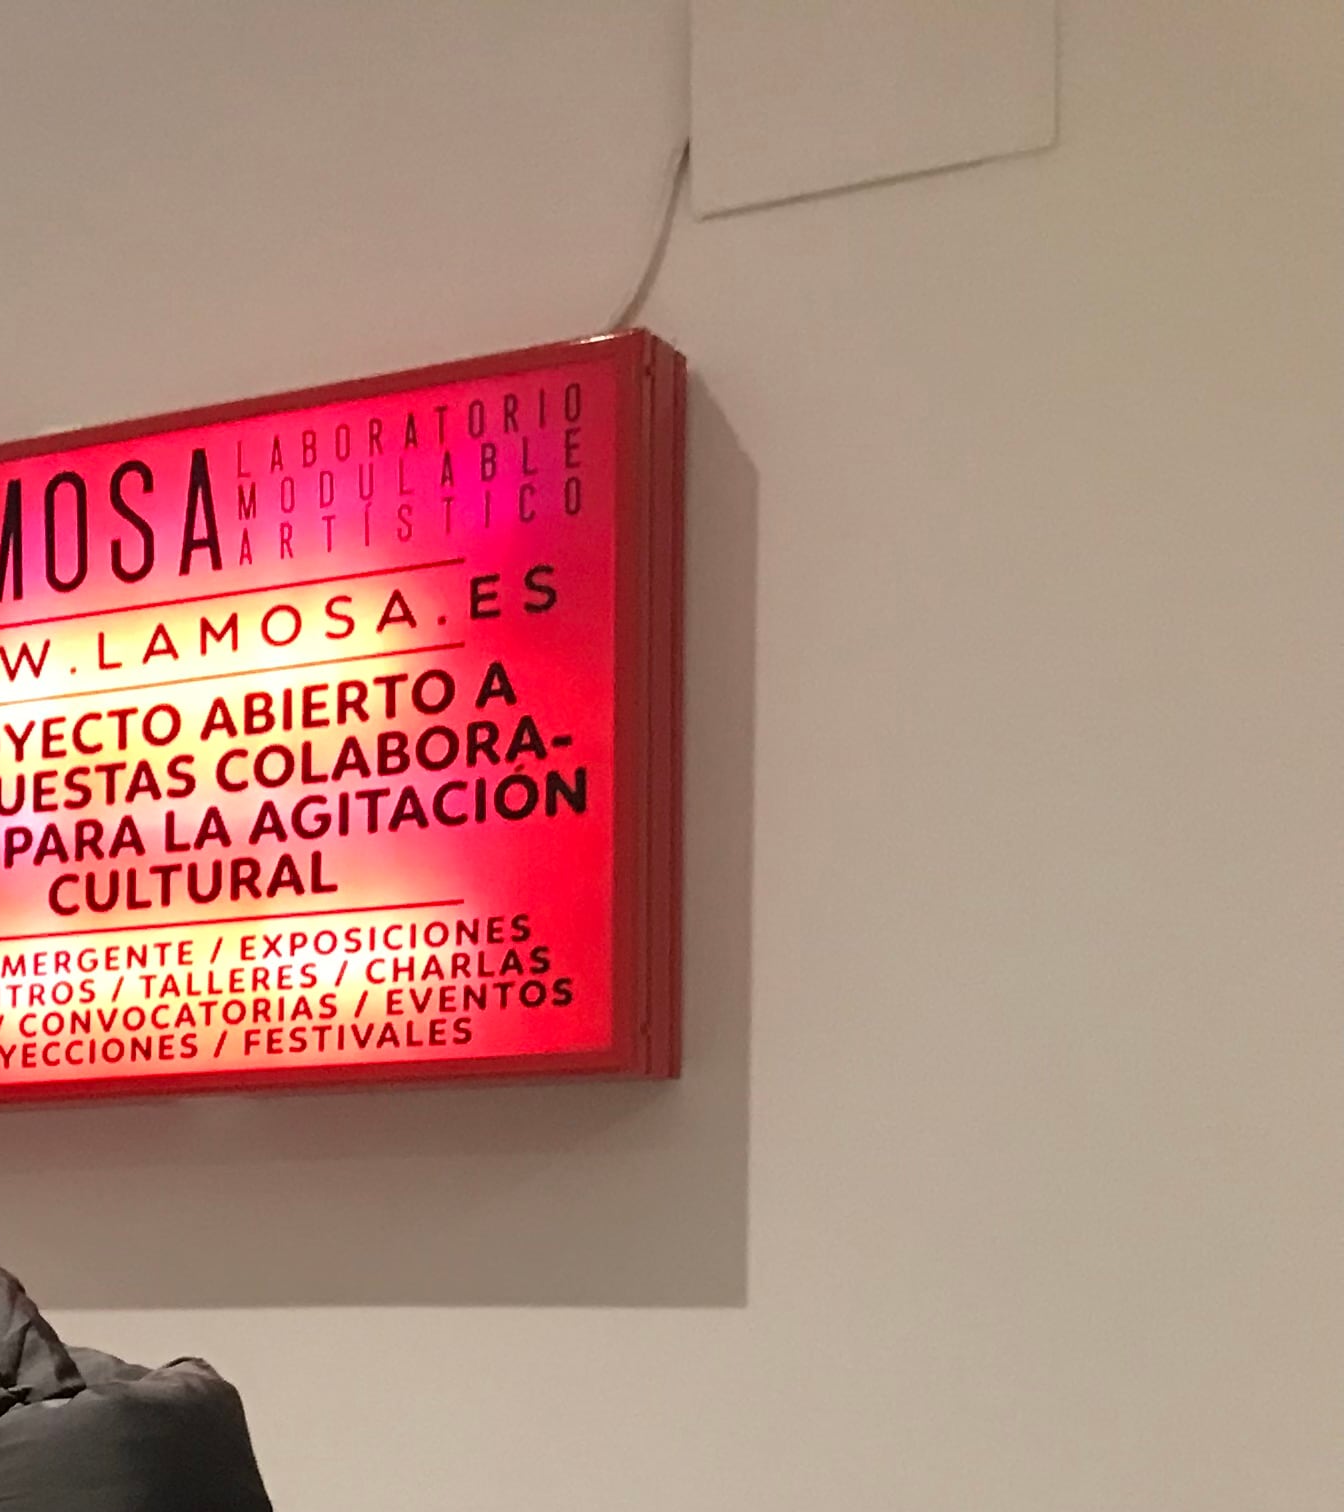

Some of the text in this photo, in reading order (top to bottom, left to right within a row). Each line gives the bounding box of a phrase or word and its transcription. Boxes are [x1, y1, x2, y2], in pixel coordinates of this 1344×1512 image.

[237, 383, 581, 478] LABORATORIO
[238, 427, 581, 520] MODULABLE
[239, 476, 581, 565] ARTÍSTICO
[200, 669, 456, 741] ABIERTO
[474, 661, 517, 708] A
[216, 715, 573, 792] COLABORA-
[4, 815, 145, 869] PARA
[165, 807, 232, 852] LA
[248, 764, 587, 843] AGITACIÓN
[49, 851, 338, 915] CULTURAL
[140, 963, 317, 998] TALLERES
[365, 946, 551, 984] CHARLAS
[241, 914, 531, 961] EXPOSICIONES
[19, 993, 338, 1038] CONVOCATORIAS
[387, 978, 574, 1014] EVENTOS
[244, 1017, 472, 1055] FESTIVALES
